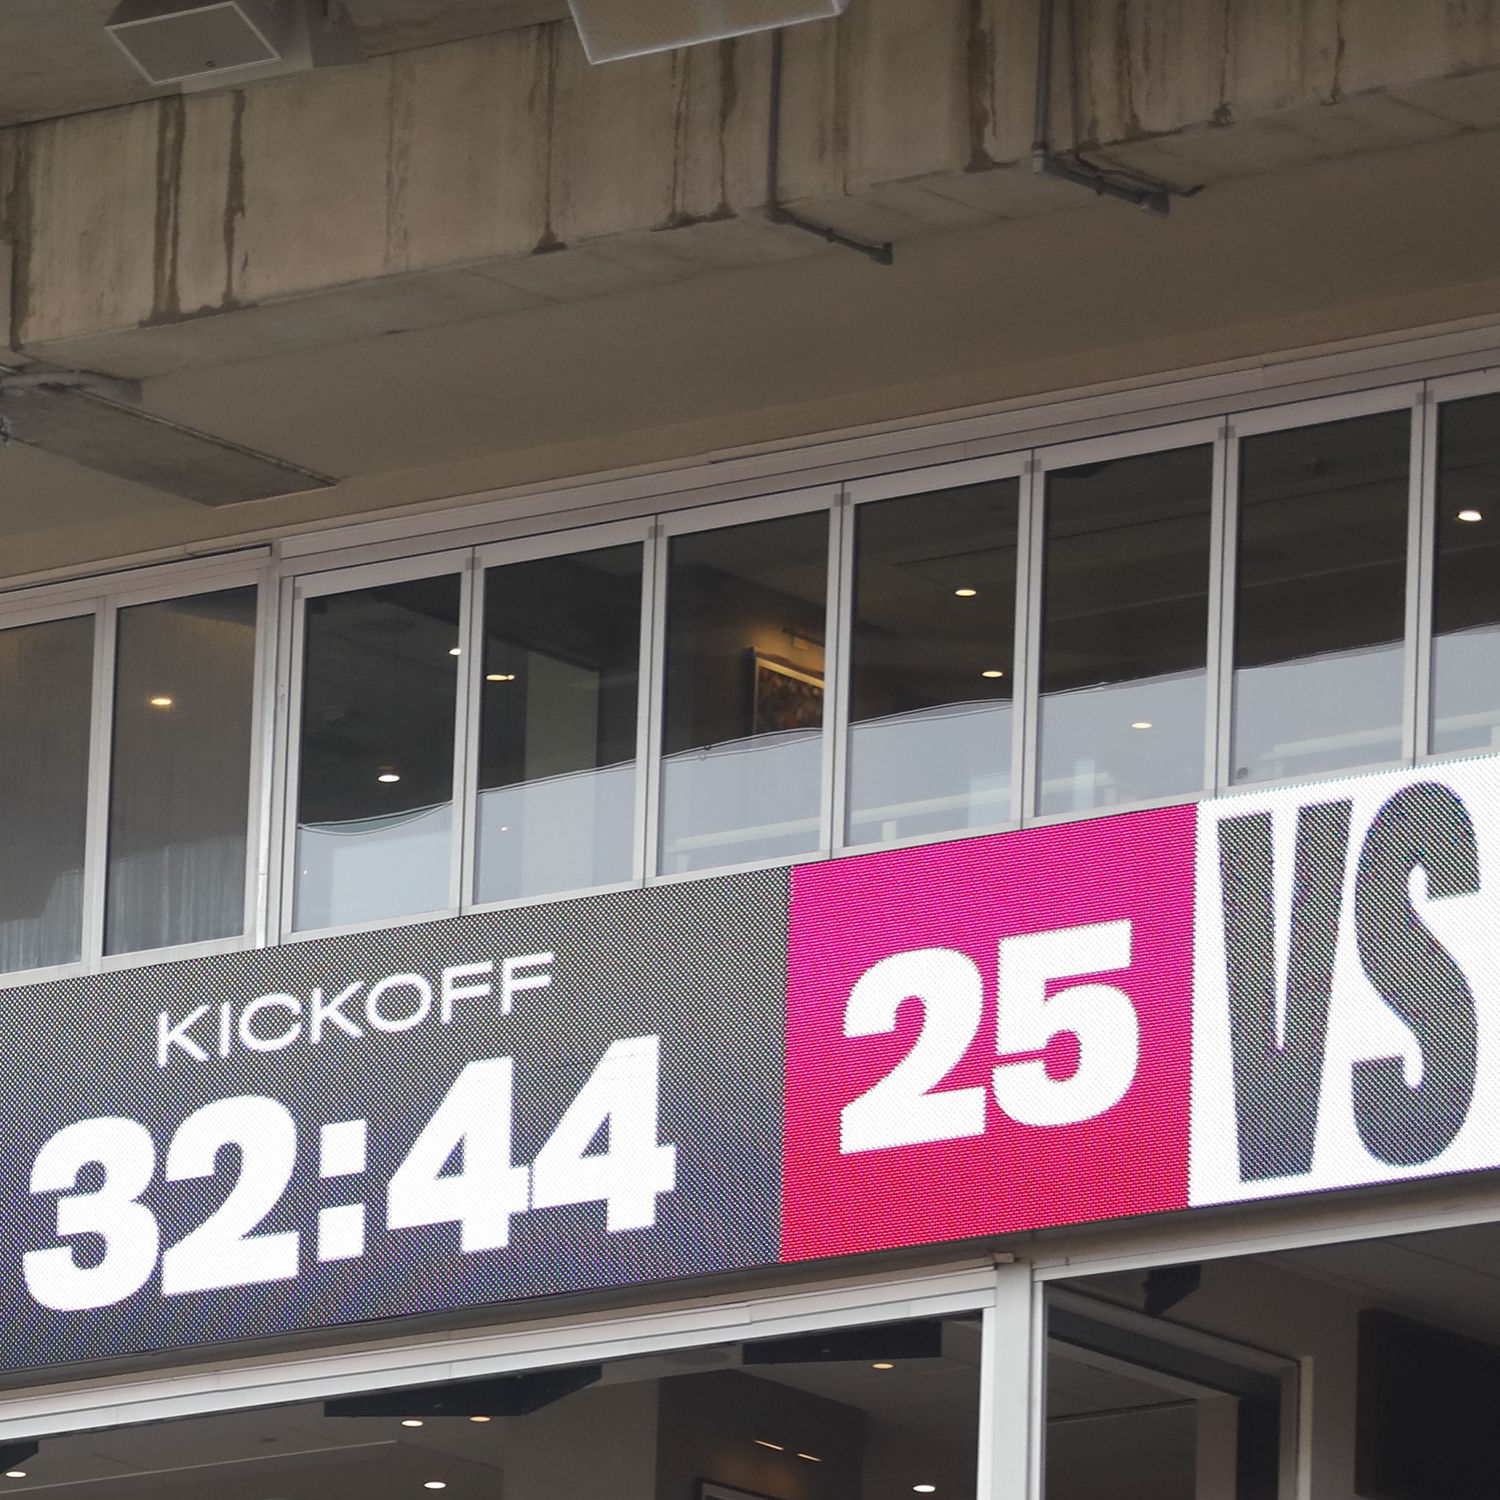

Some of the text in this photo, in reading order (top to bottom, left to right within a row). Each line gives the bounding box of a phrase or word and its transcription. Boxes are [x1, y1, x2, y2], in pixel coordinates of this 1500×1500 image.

[157, 952, 555, 1067] KICKOFF
[840, 919, 1141, 1154] 25
[1217, 781, 1481, 1183] VS
[22, 1035, 676, 1311] 32:44
